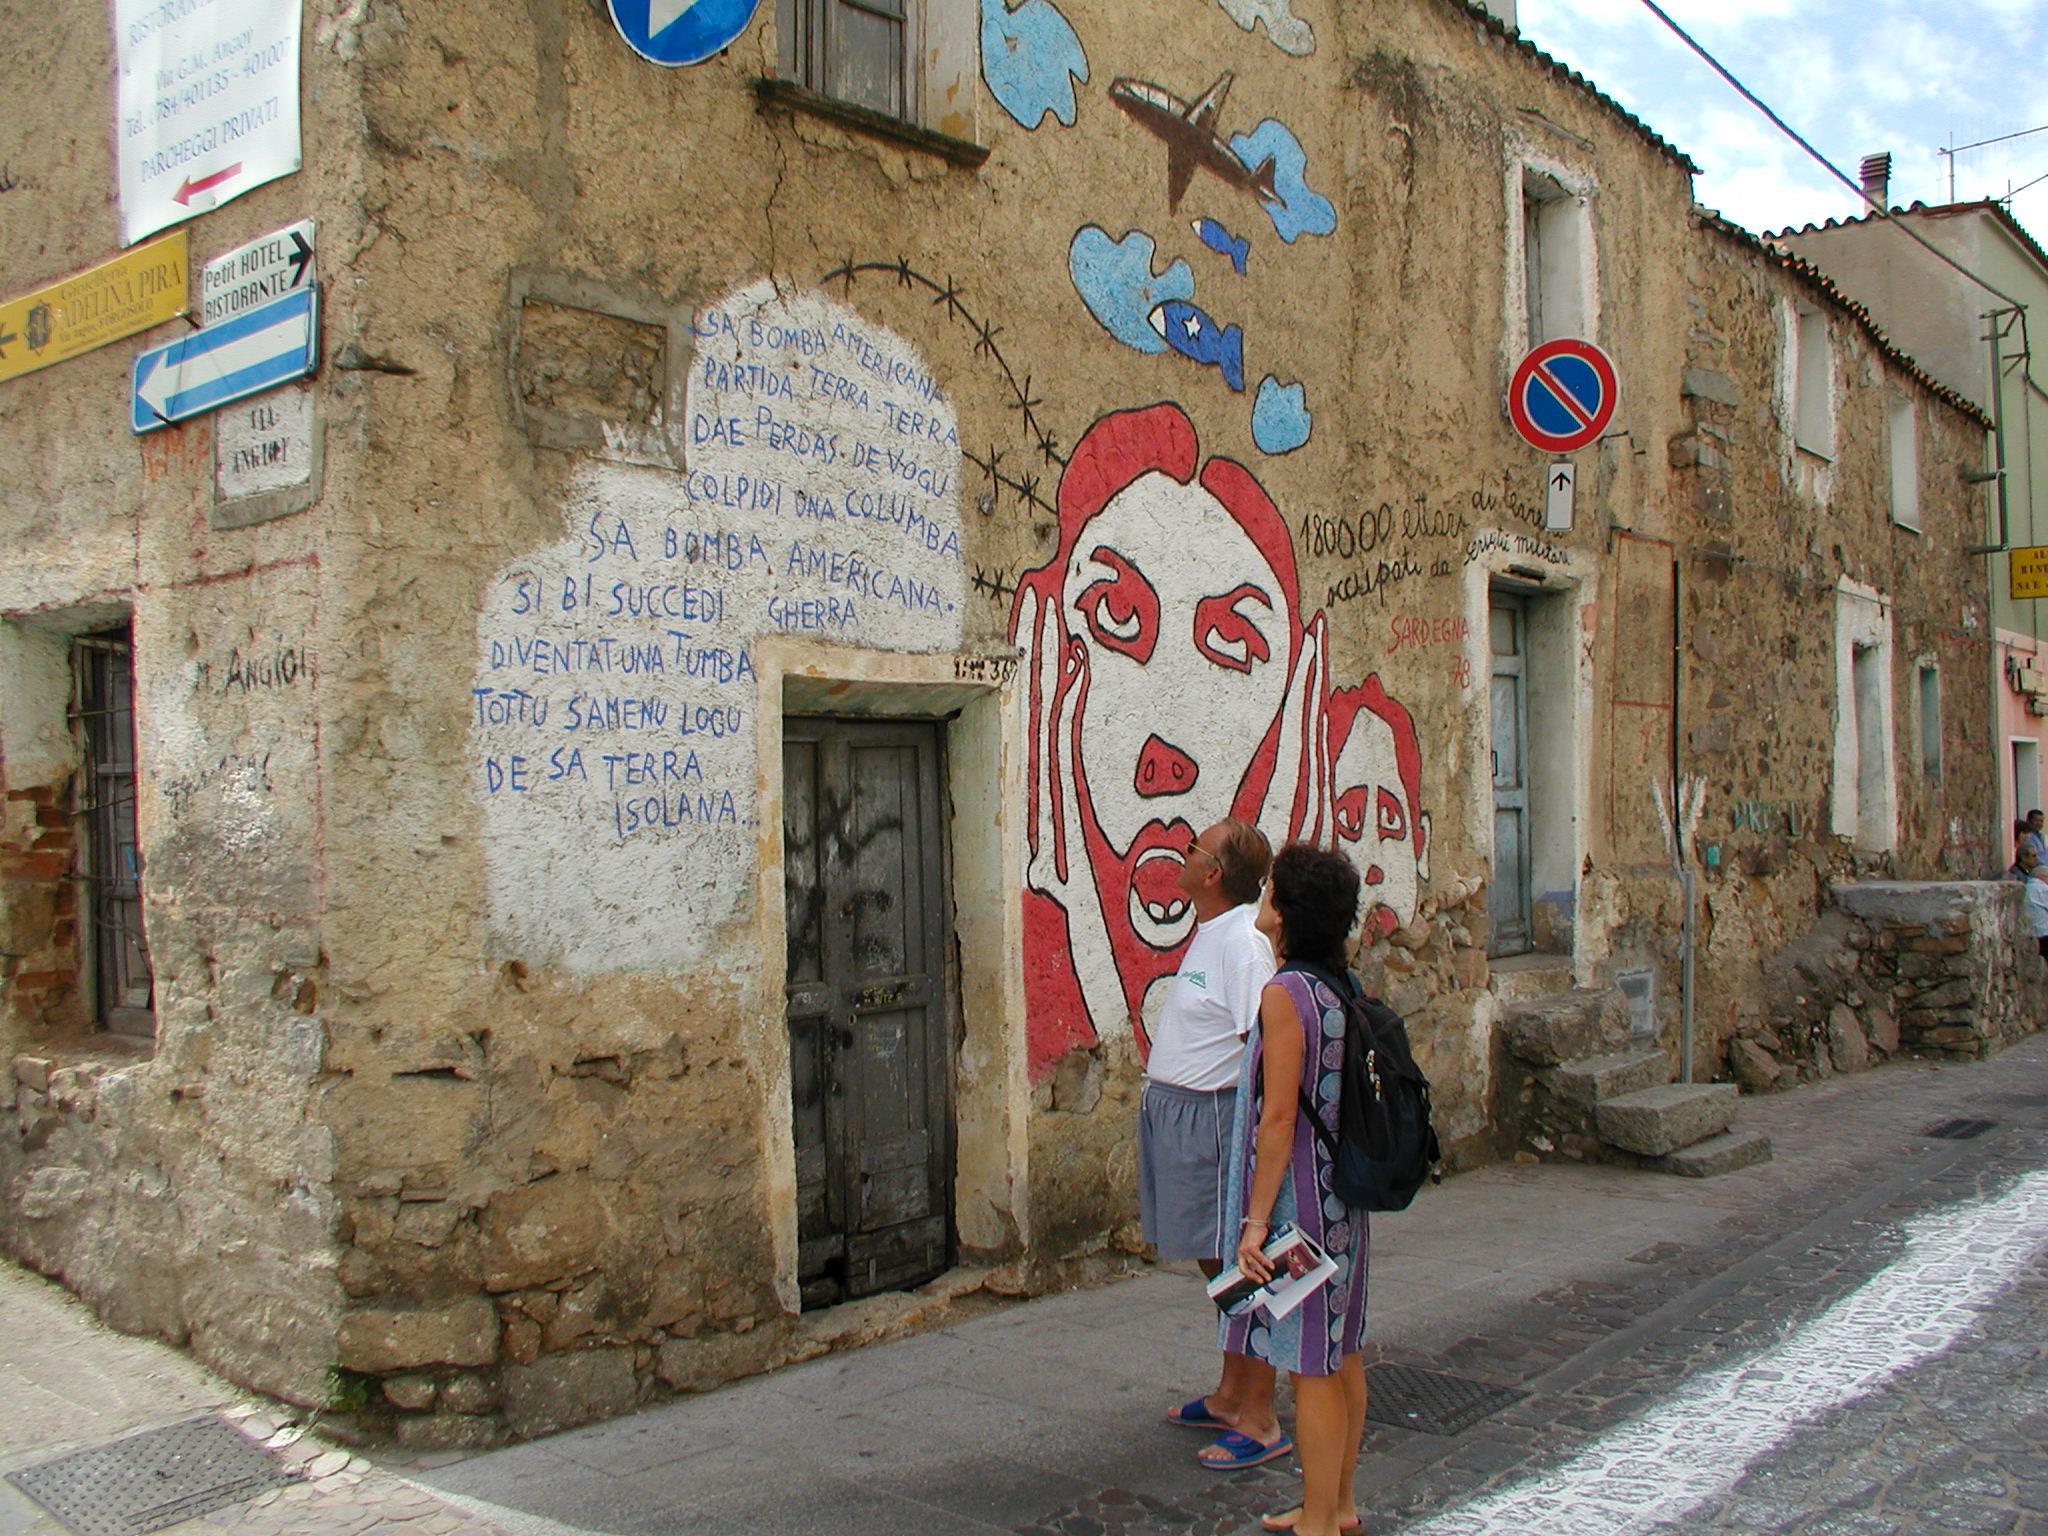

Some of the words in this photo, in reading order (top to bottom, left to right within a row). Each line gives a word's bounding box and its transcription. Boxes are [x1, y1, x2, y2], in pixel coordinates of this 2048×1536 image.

[140, 127, 219, 182] PARCHEGGI
[223, 96, 280, 144] PRIVATI
[138, 260, 182, 299] PIRA
[205, 260, 236, 293] Petit
[241, 240, 285, 277] HOTEL
[205, 270, 288, 323] RISTORANTE
[684, 310, 737, 338] SA
[751, 319, 828, 356] BOMBA
[833, 322, 949, 405] AMERICANA
[704, 356, 794, 400] PARTIDA
[695, 413, 745, 448] DAE
[756, 405, 839, 465] PERDAS
[589, 511, 639, 563] SA
[665, 527, 768, 571] BOMBA
[686, 469, 782, 516] COLPIDI
[794, 490, 838, 522] UNA
[845, 488, 962, 561] COLUMBA
[512, 577, 543, 615] SI
[562, 573, 592, 612] BI
[608, 582, 724, 623] SUCCEDI
[767, 595, 859, 630] GHERRA
[667, 629, 758, 684] TUMBA
[1383, 615, 1470, 654] SARDEGNA
[1450, 655, 1470, 689] 78
[472, 687, 549, 727] TOTTU
[681, 703, 741, 738] LOGU
[487, 756, 528, 793] DE
[549, 747, 588, 780] SA
[602, 750, 703, 791] TERRA
